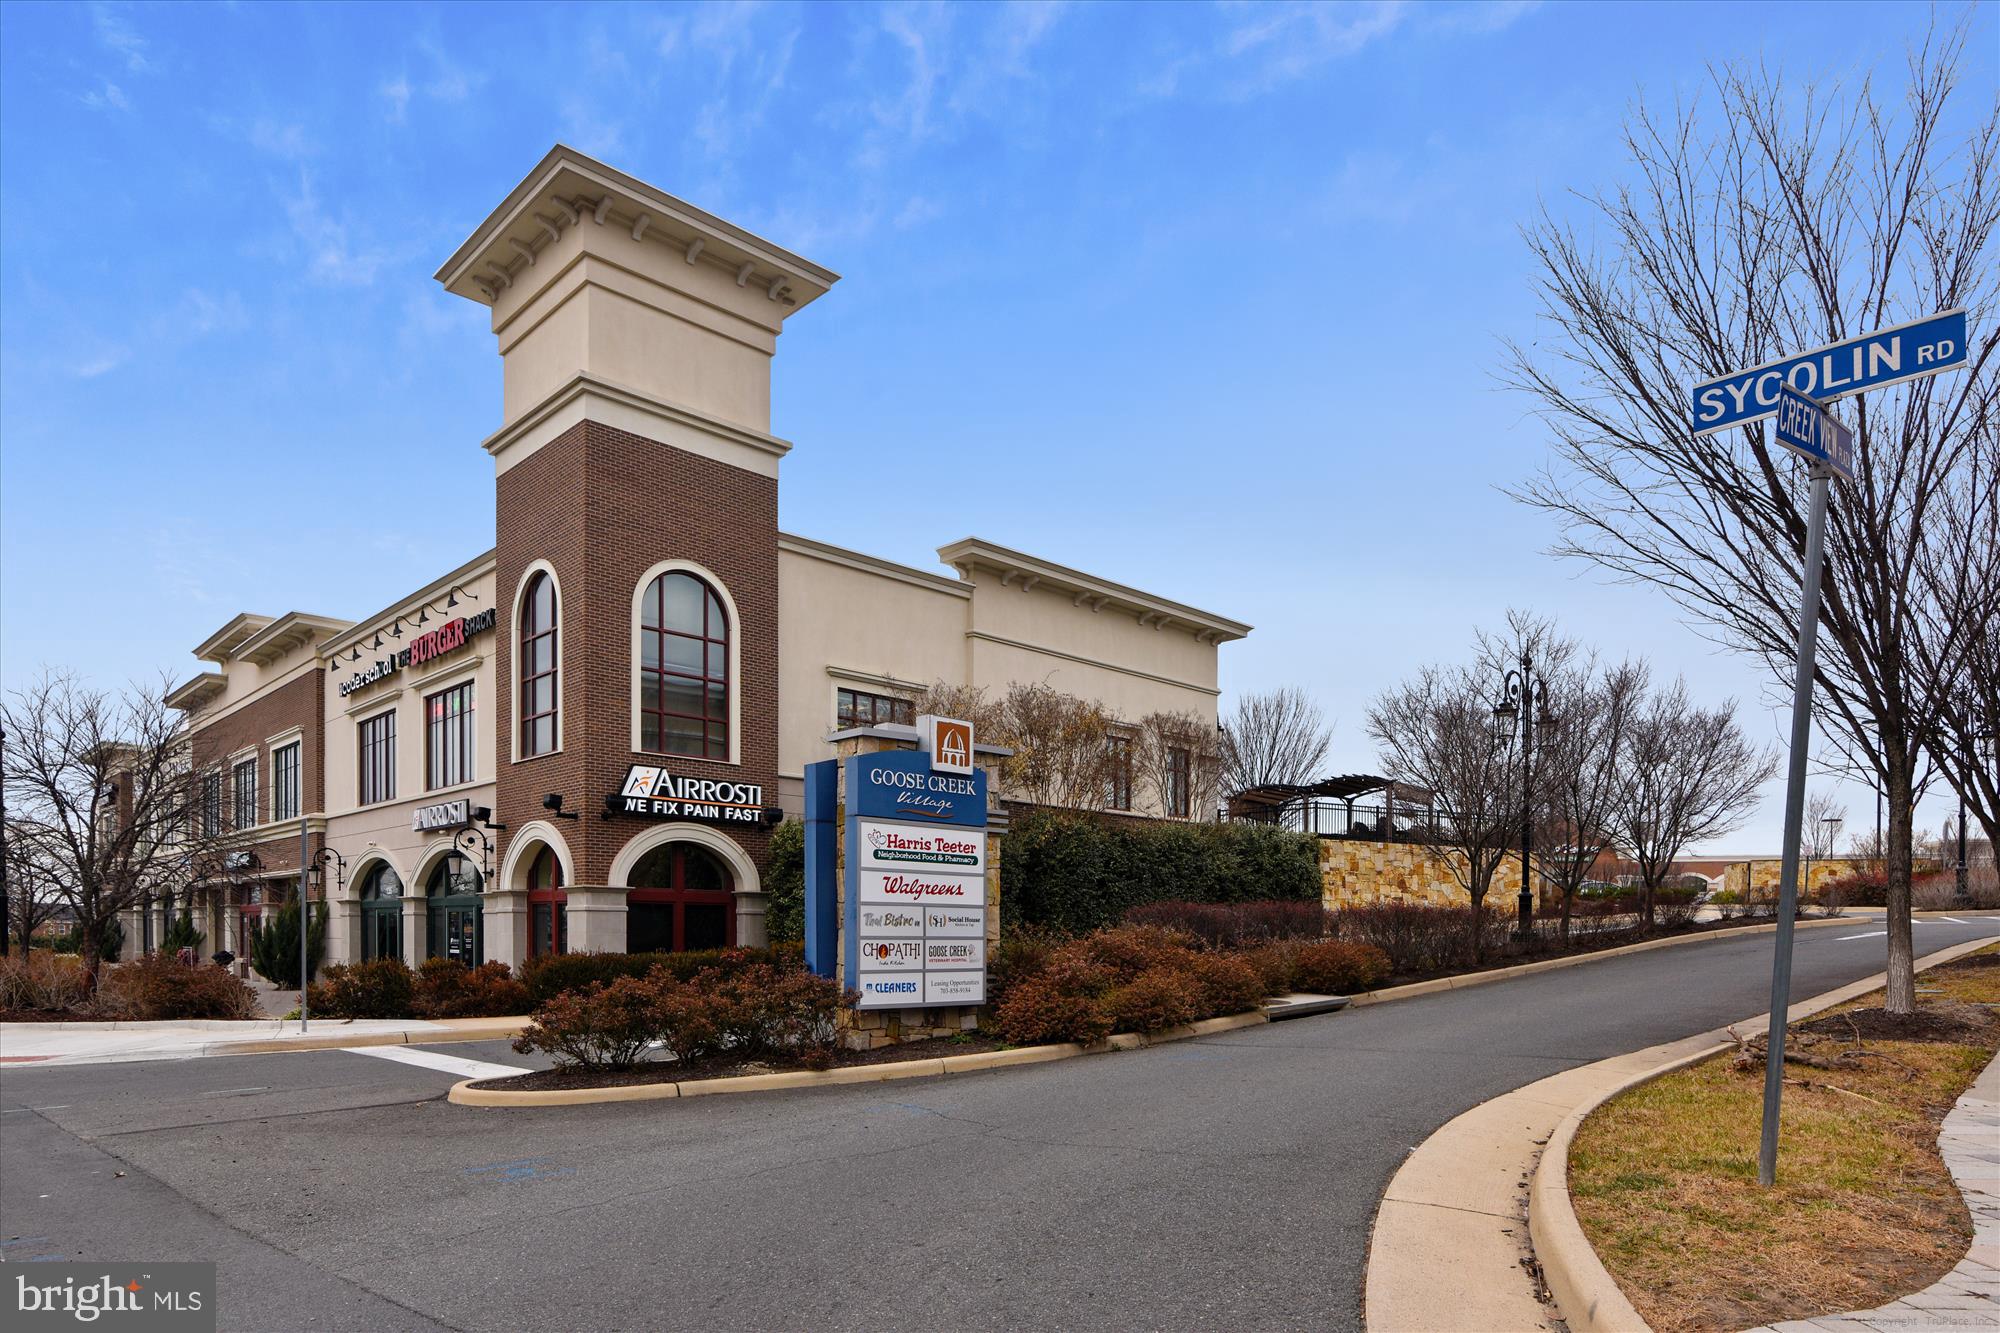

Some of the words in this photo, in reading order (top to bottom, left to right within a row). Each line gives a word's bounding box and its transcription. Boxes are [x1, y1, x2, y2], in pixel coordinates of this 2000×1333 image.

[1699, 336, 1901, 423] SYCOLIN
[1917, 340, 1955, 365] RD
[1779, 394, 1817, 447] CREEK
[397, 647, 411, 668] THE
[409, 617, 465, 666] BURGER
[464, 608, 494, 637] SHACK
[652, 768, 762, 806] AIRROSTI
[870, 768, 925, 790] GOOSE
[928, 775, 976, 796] CREEK
[652, 801, 679, 815] FIX
[683, 804, 719, 819] PAIN
[724, 807, 762, 822] FAST
[896, 791, 954, 814] Village
[886, 833, 931, 851] Harris
[935, 837, 976, 854] Teeter
[877, 850, 921, 860] Neighborhood
[922, 853, 937, 861] Food
[944, 855, 975, 865] Pharmacy
[883, 876, 964, 900] Walgreens
[884, 912, 914, 928] Bistro
[863, 942, 921, 960] CHOPATHI
[928, 945, 948, 957] GOOSE
[949, 945, 968, 957] CREEK
[875, 982, 917, 994] CLEANERS
